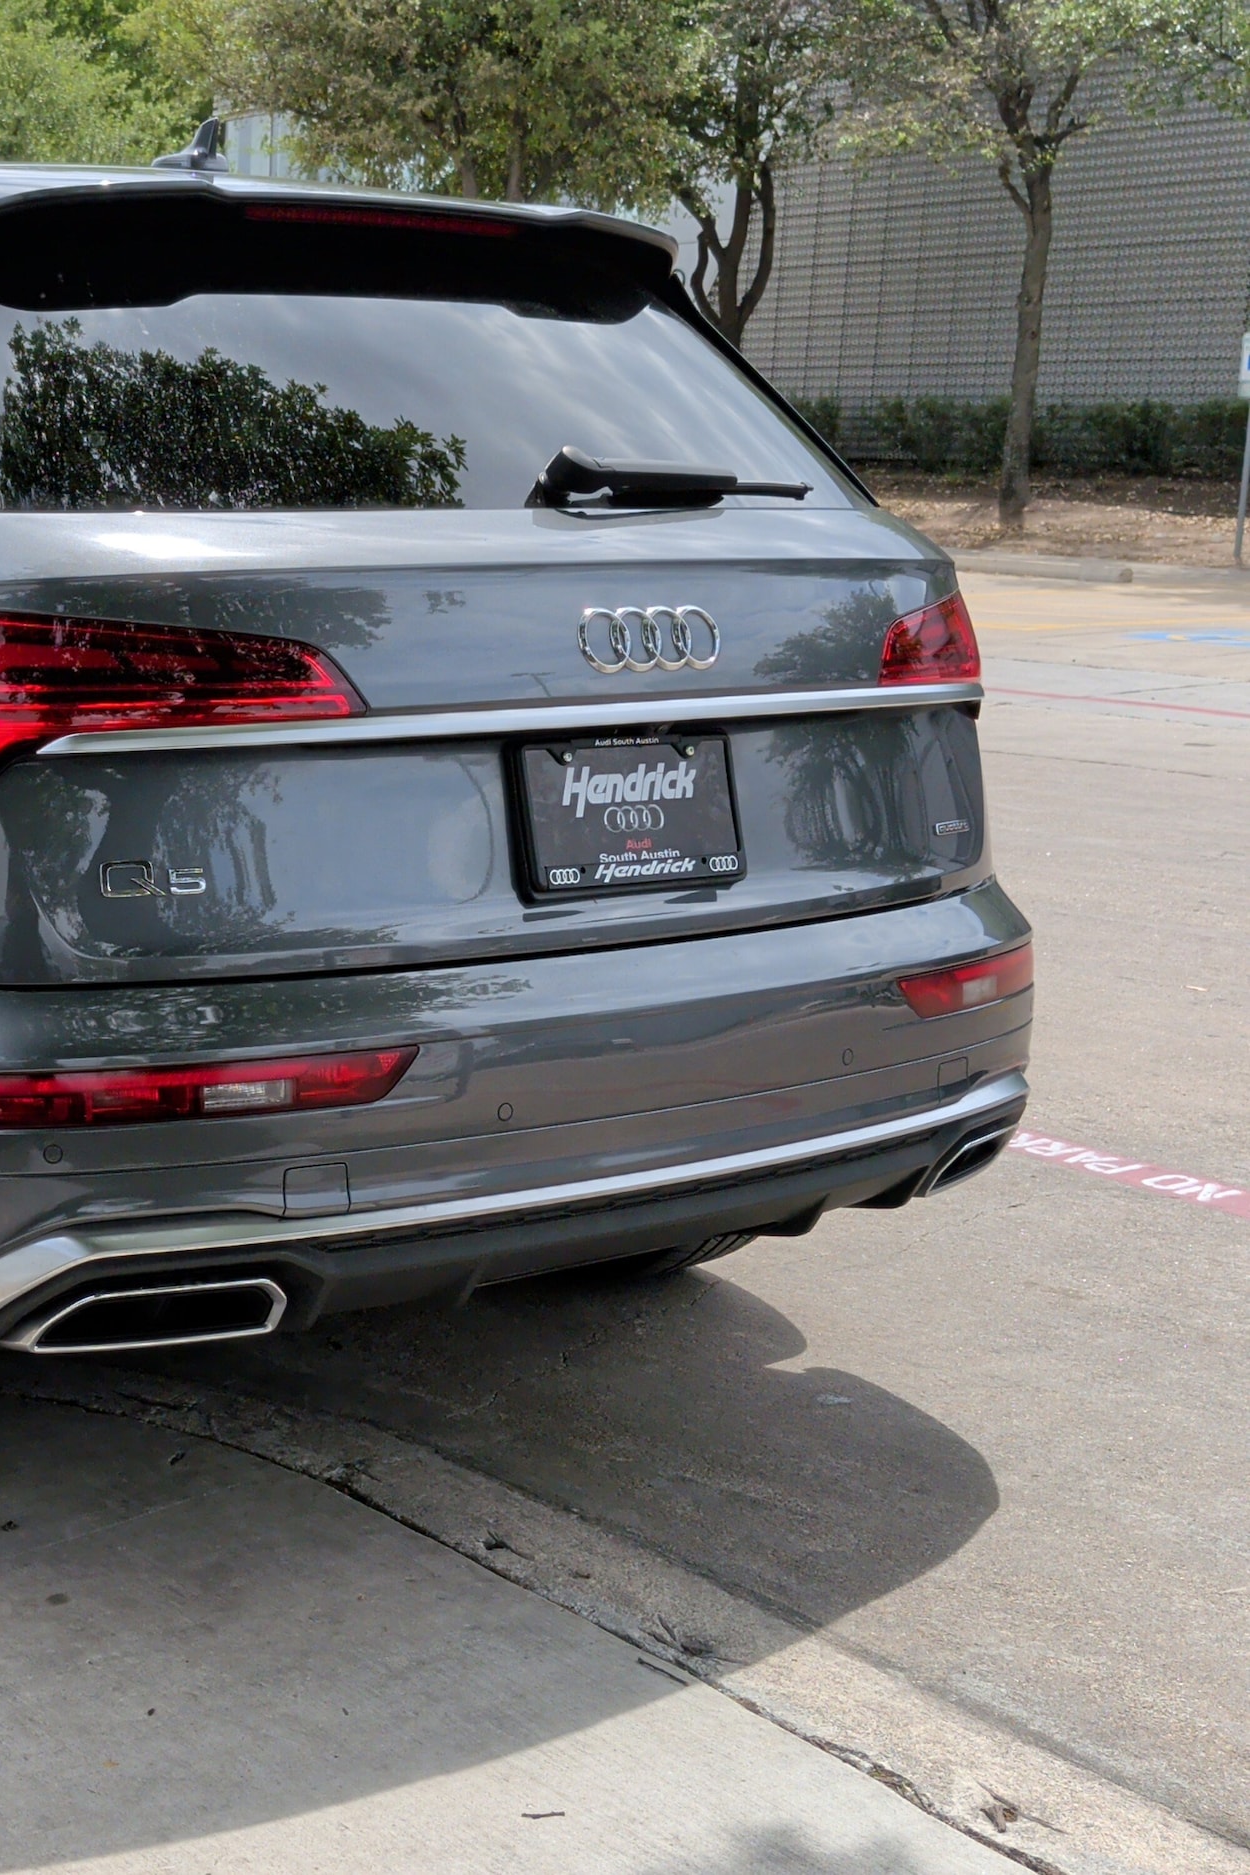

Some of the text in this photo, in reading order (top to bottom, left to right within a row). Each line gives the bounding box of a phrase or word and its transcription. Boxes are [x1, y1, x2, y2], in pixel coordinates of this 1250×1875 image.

[594, 736, 660, 746] Audi South Austin
[561, 761, 697, 818] Hendrick
[599, 848, 680, 863] South Austin
[626, 838, 653, 850] Audi
[100, 860, 207, 898] Q5
[594, 857, 696, 883] Hendrick
[1141, 1174, 1242, 1202] NO
